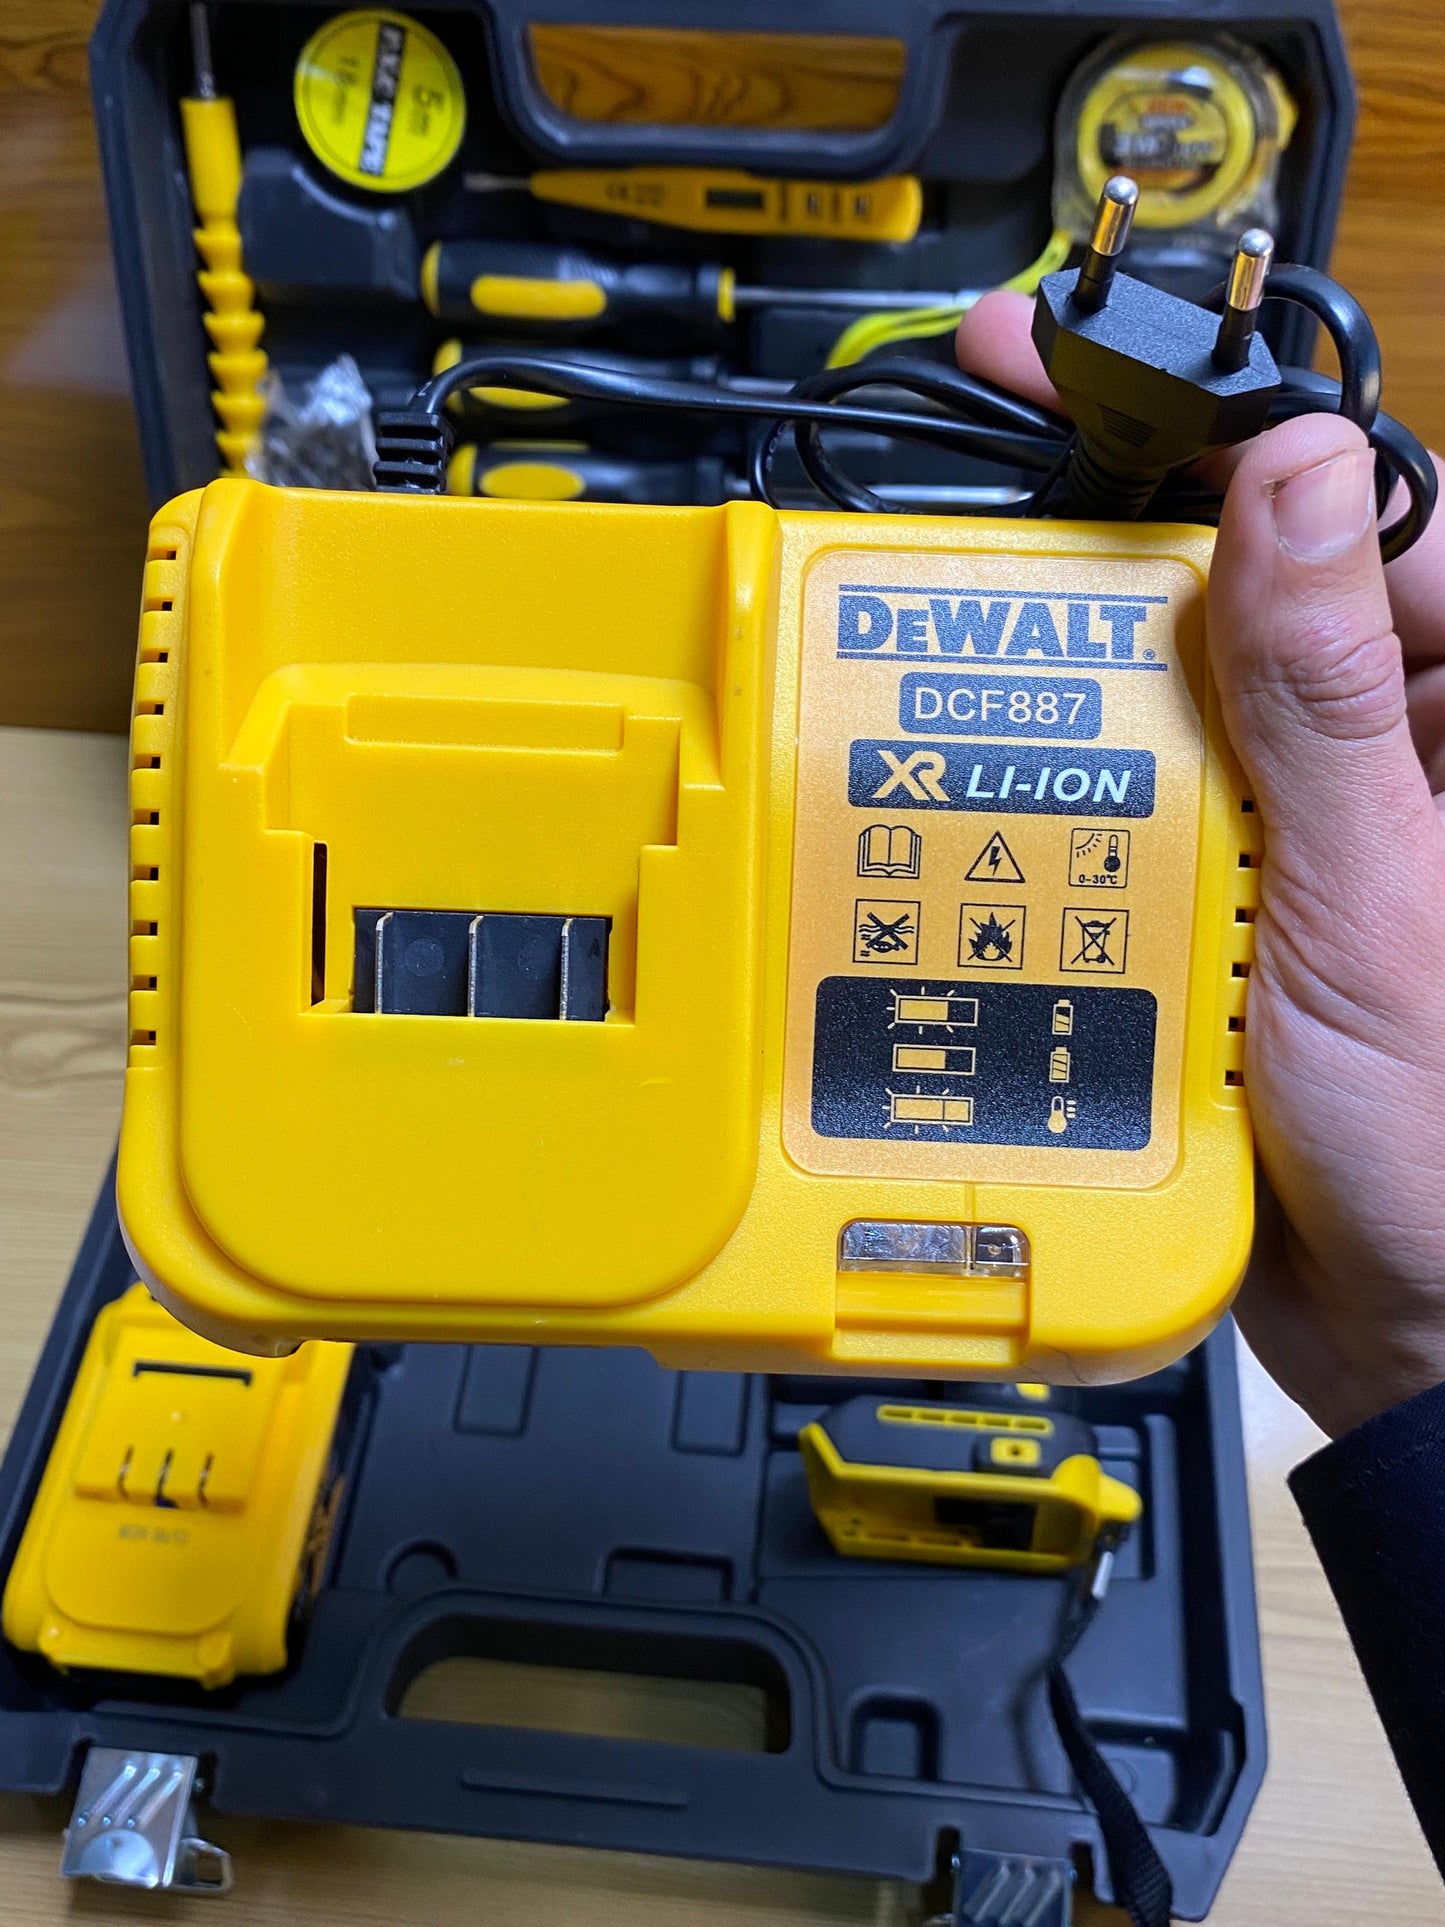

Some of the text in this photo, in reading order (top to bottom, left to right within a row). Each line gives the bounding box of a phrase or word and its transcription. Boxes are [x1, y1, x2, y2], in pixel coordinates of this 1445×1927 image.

[914, 687, 1086, 725] DCF887
[872, 750, 1131, 804] XR LI-ION
